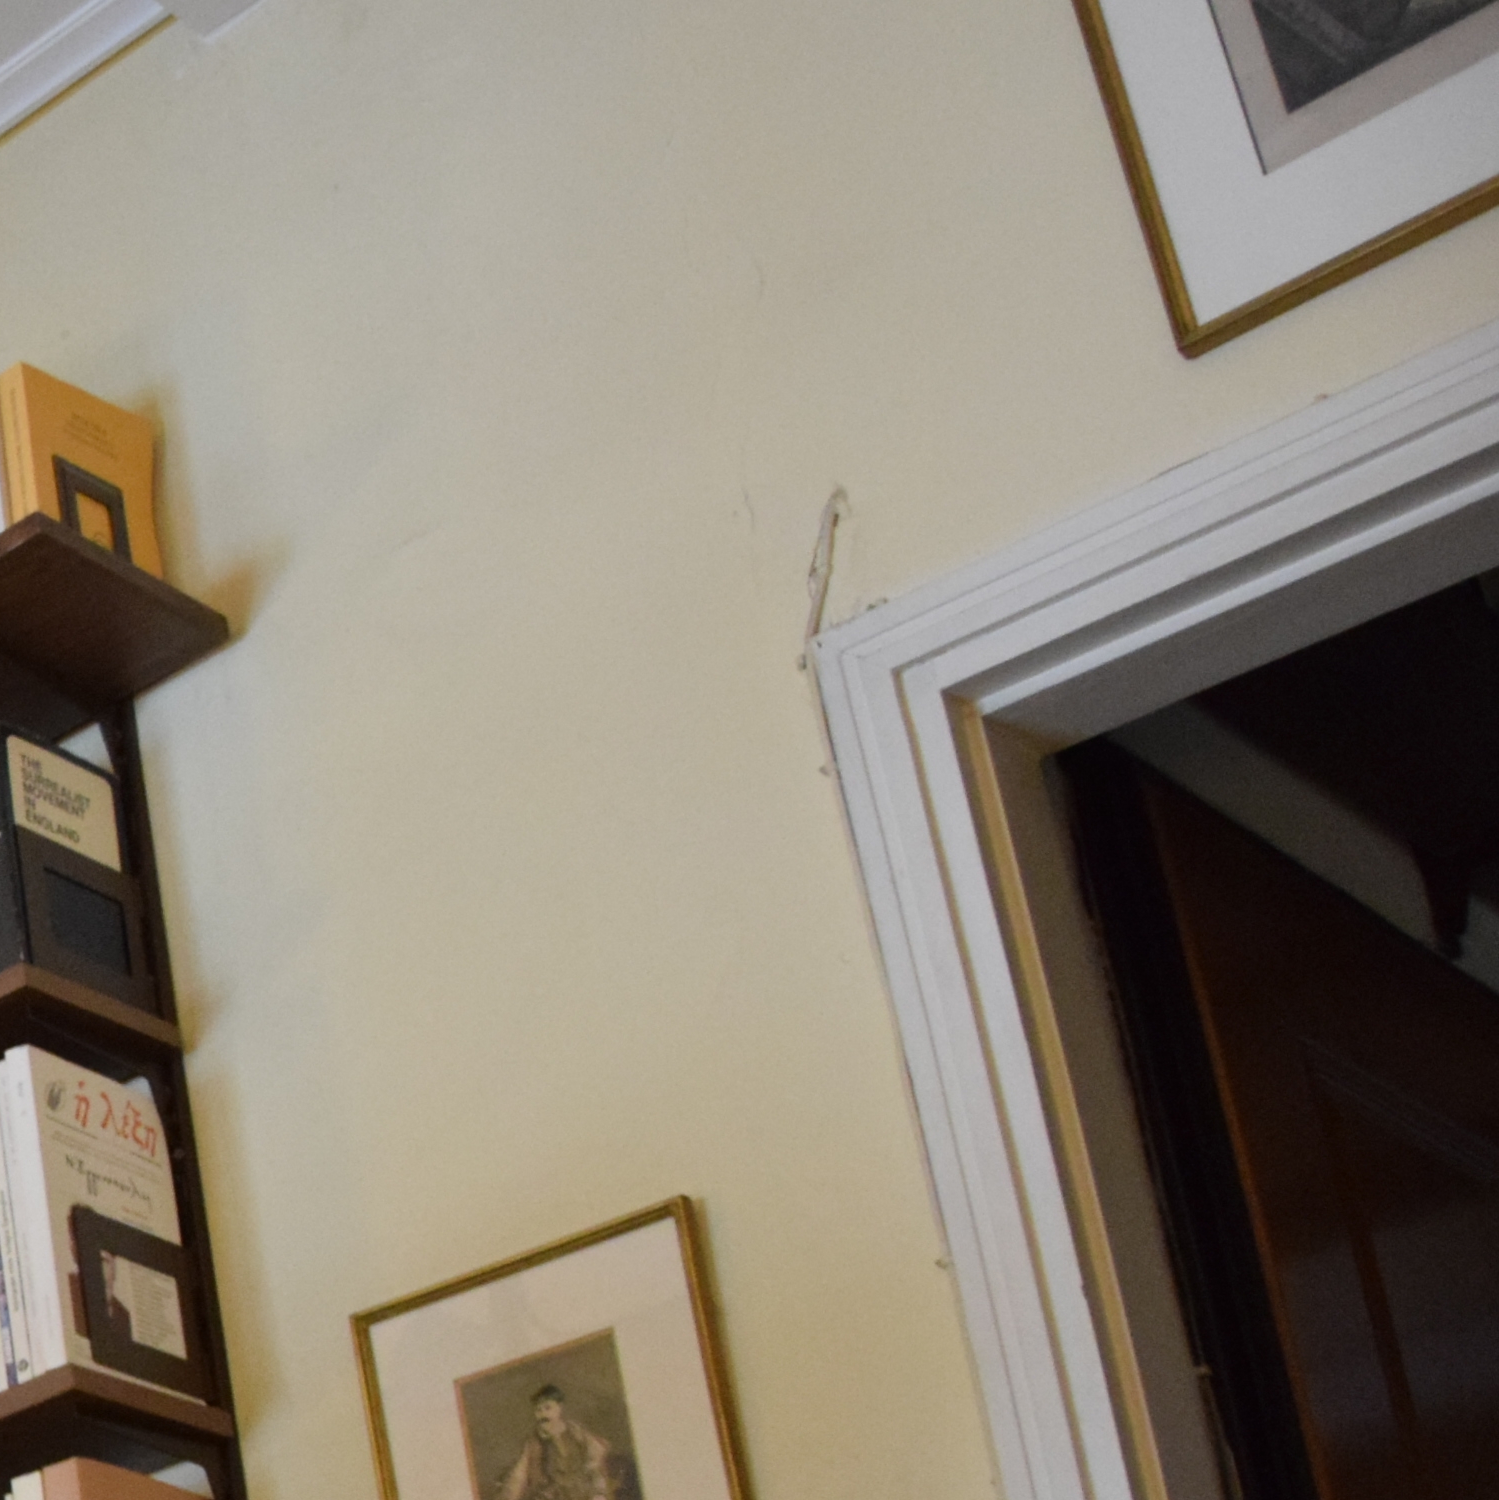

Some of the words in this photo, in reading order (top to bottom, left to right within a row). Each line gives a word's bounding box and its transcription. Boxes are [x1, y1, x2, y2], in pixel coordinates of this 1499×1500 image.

[20, 753, 41, 773] THE
[21, 767, 91, 809] SURREALIST
[23, 783, 86, 819] MOVEMENT
[24, 797, 36, 811] IN
[25, 809, 80, 843] ENGLAND
